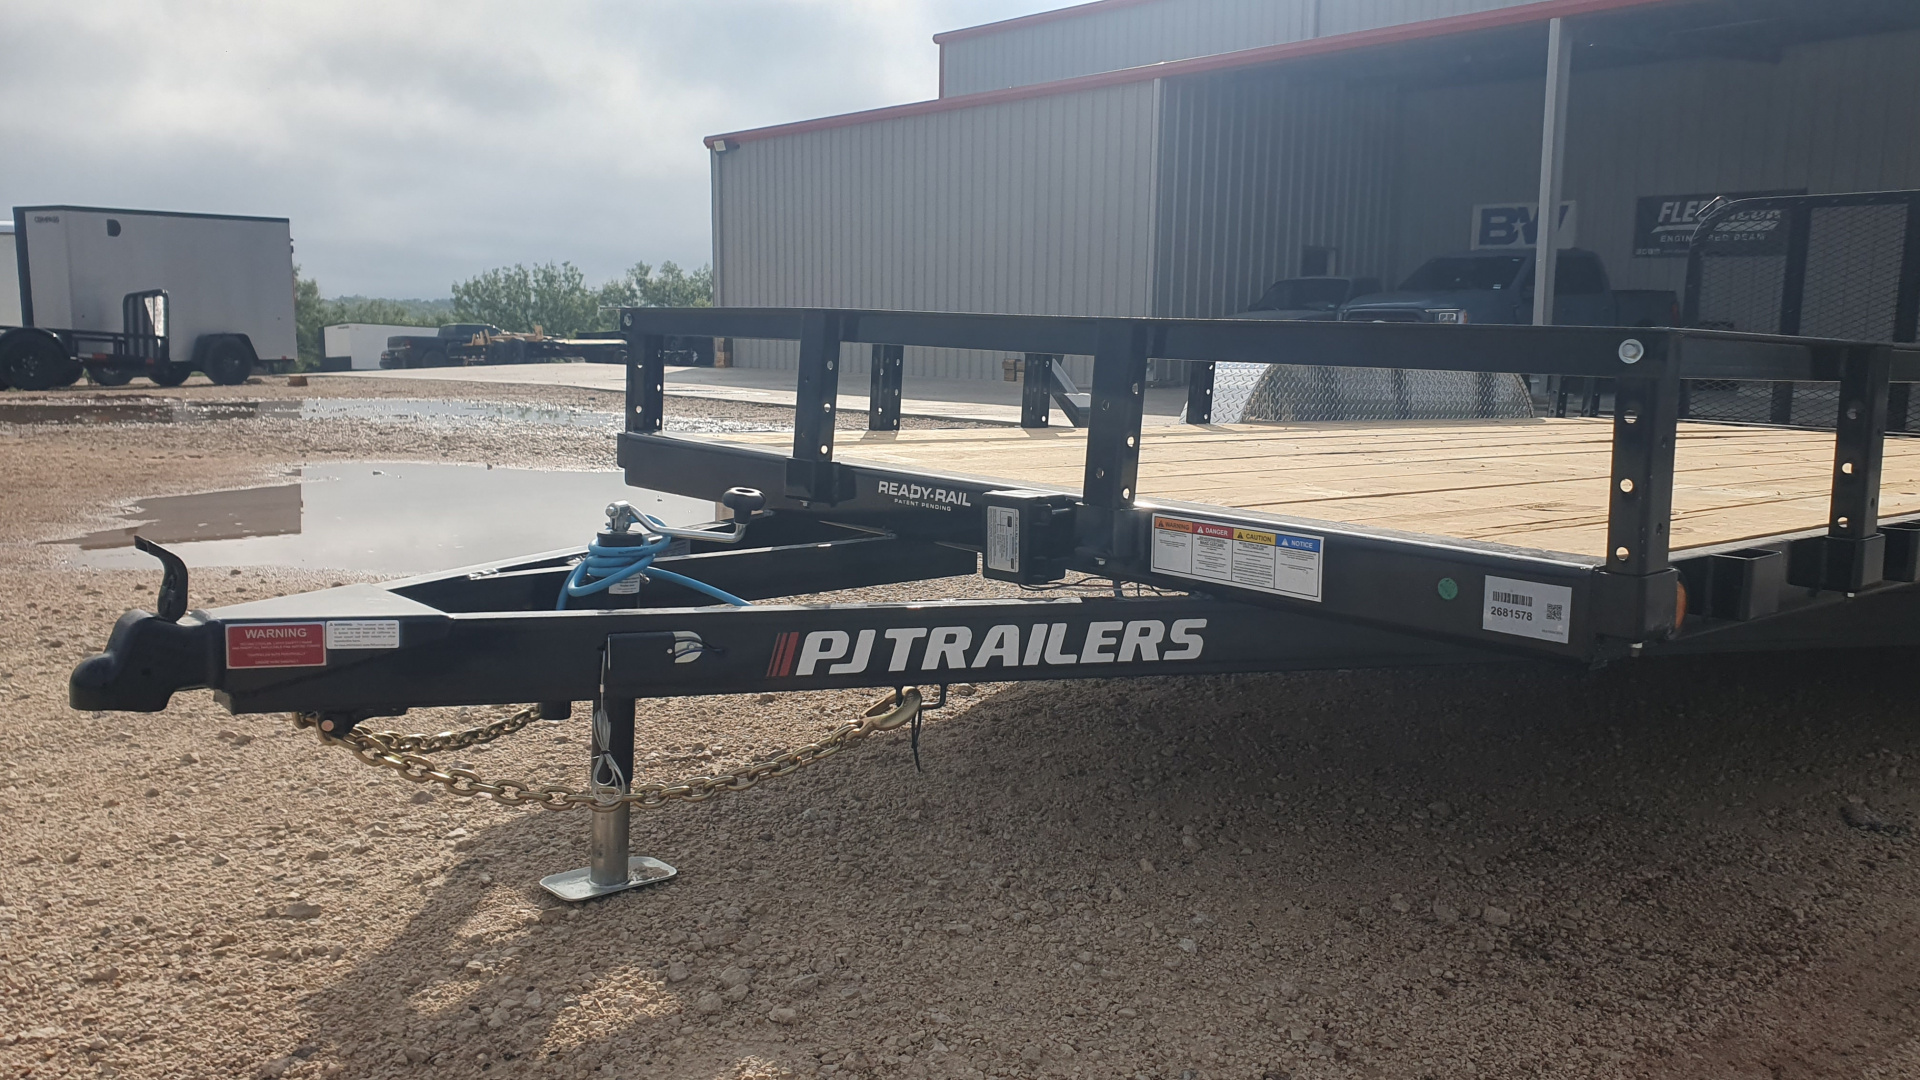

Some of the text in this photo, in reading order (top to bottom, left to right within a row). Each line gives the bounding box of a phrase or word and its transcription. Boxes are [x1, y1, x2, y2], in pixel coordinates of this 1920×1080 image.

[894, 498, 952, 512] PATENT PENDING
[1165, 521, 1190, 531] WARNING
[1205, 527, 1228, 537] DANGER
[1245, 533, 1272, 543] CAUTION
[1291, 540, 1313, 549] NOTICE
[1490, 606, 1533, 621] 2681578
[244, 628, 307, 639] WARNING
[796, 618, 1208, 676] PJ TRAILERS
